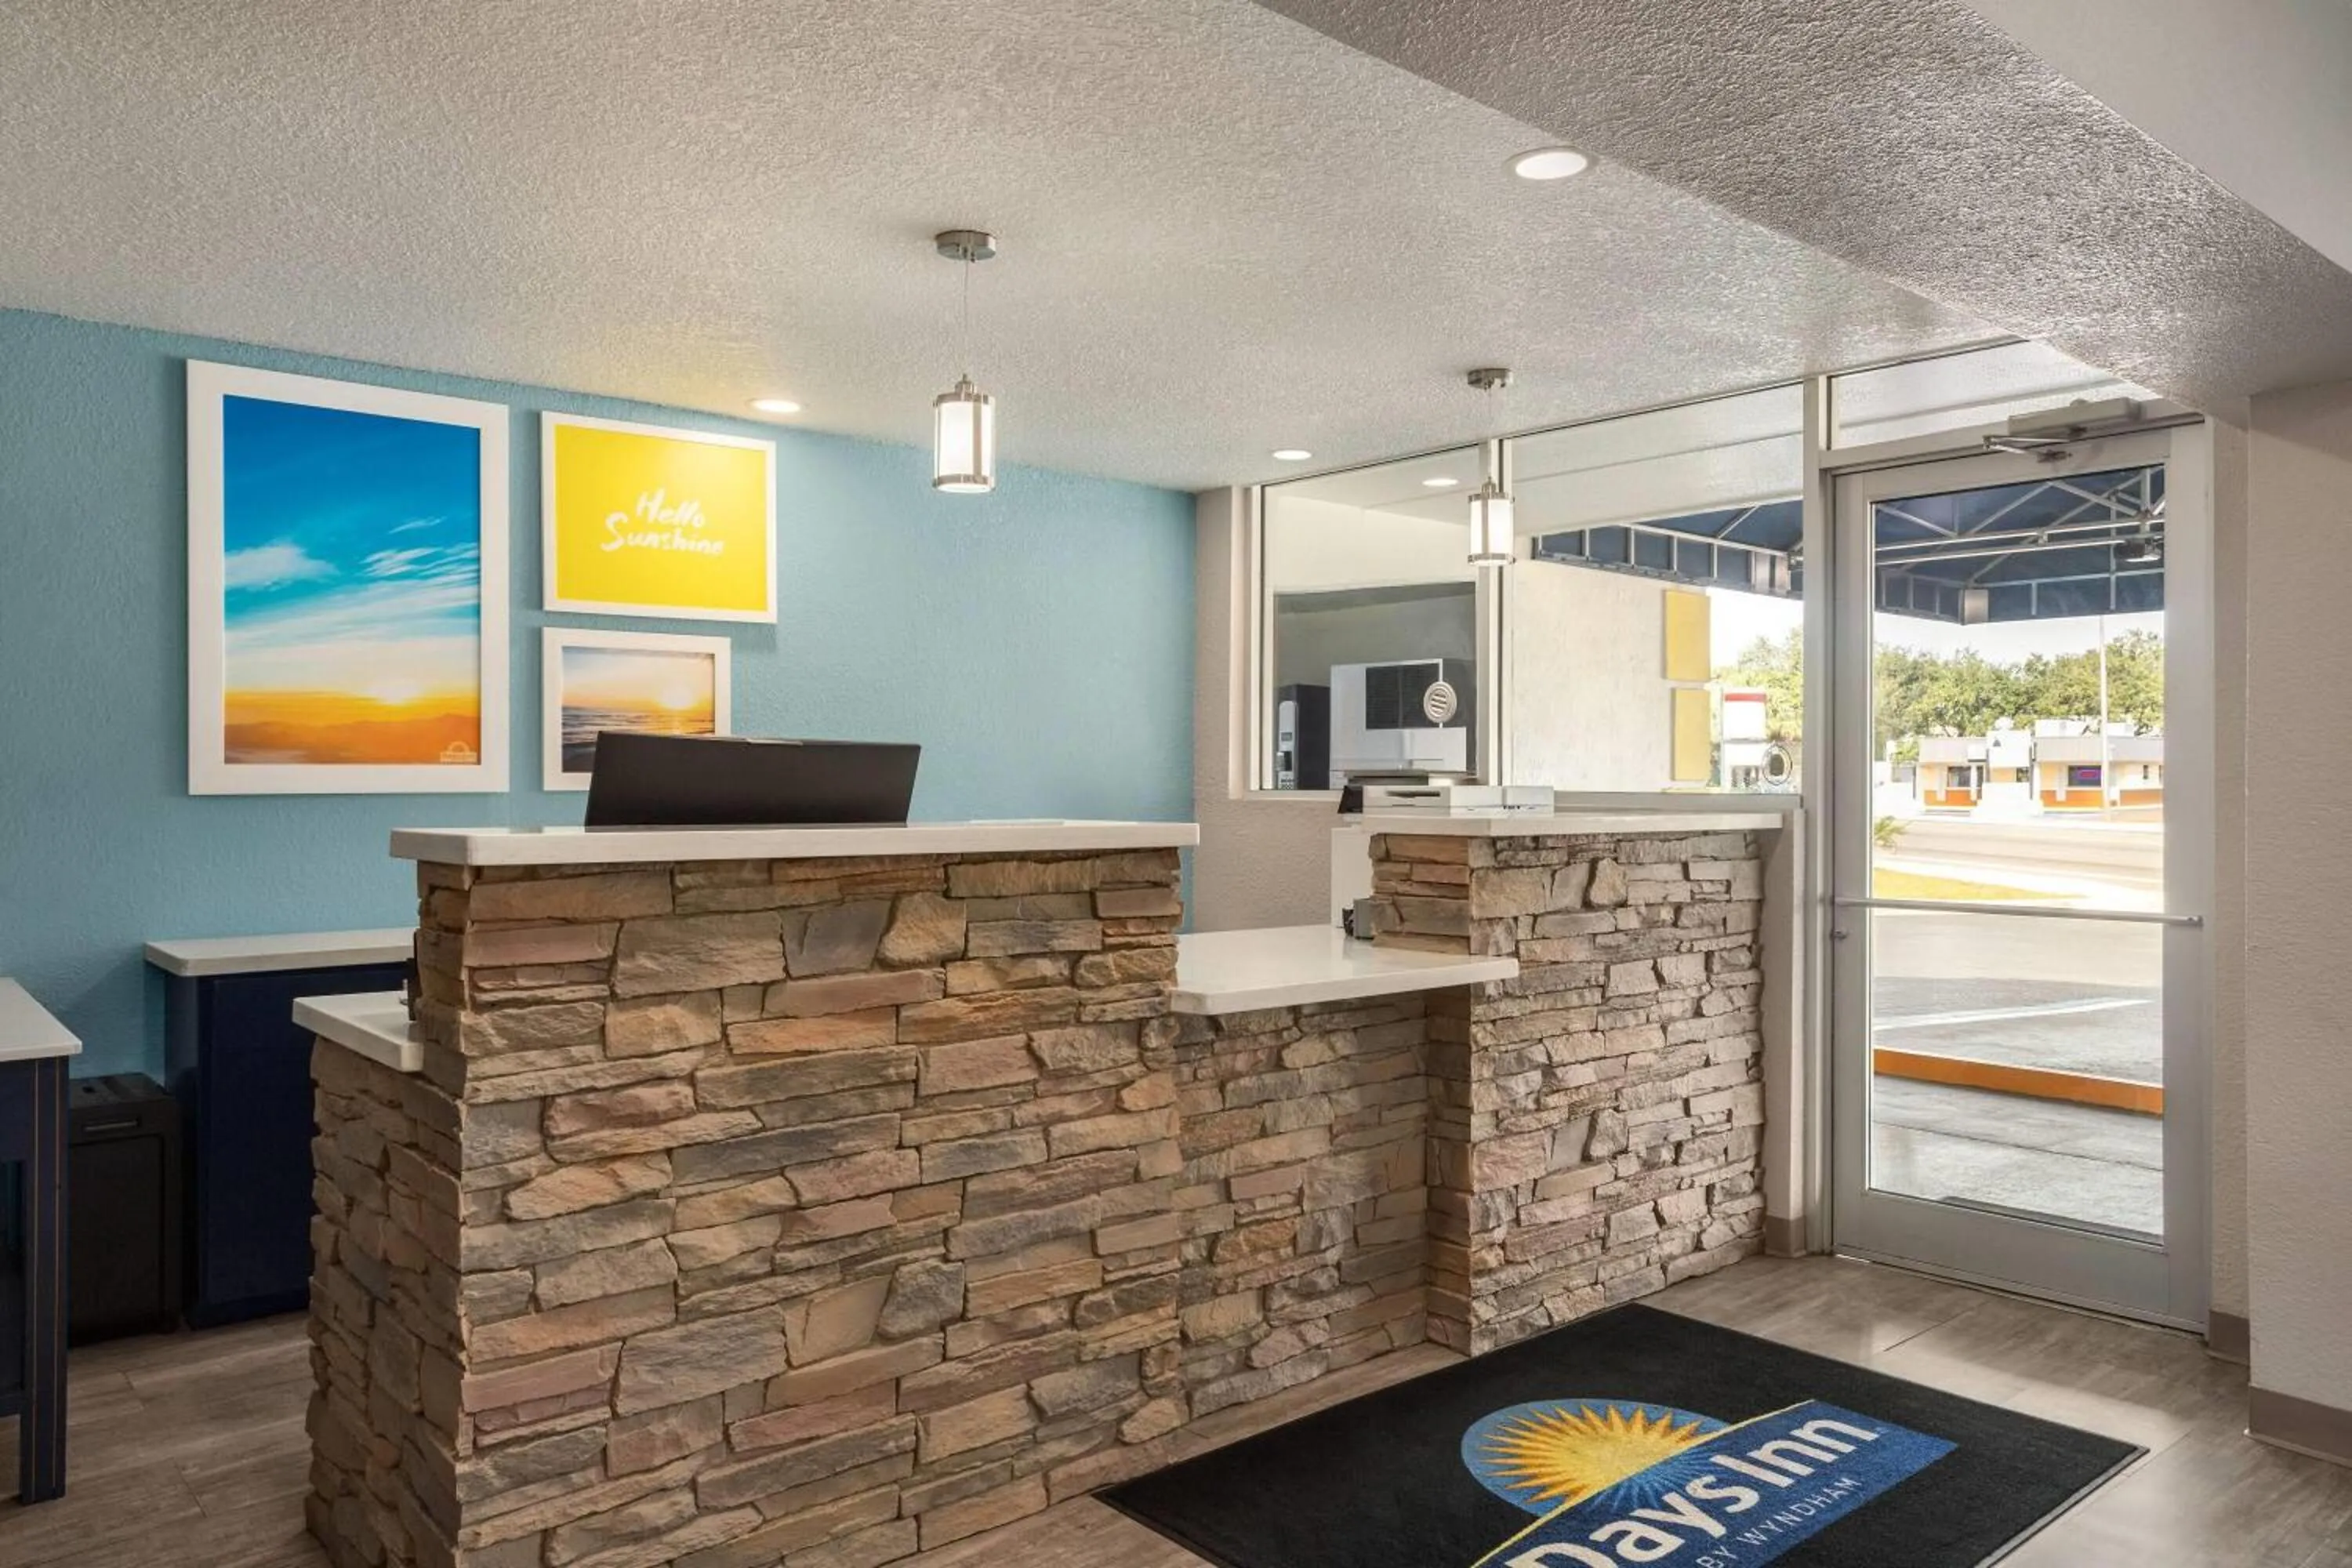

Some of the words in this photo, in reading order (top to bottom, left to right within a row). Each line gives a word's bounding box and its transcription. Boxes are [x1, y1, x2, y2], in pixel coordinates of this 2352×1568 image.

[601, 510, 725, 556] Sunshine
[635, 487, 706, 528] Hello
[1709, 1419, 1879, 1488] Inn
[1696, 1544, 1737, 1568] BY
[1737, 1477, 1862, 1546] WYNDHAM
